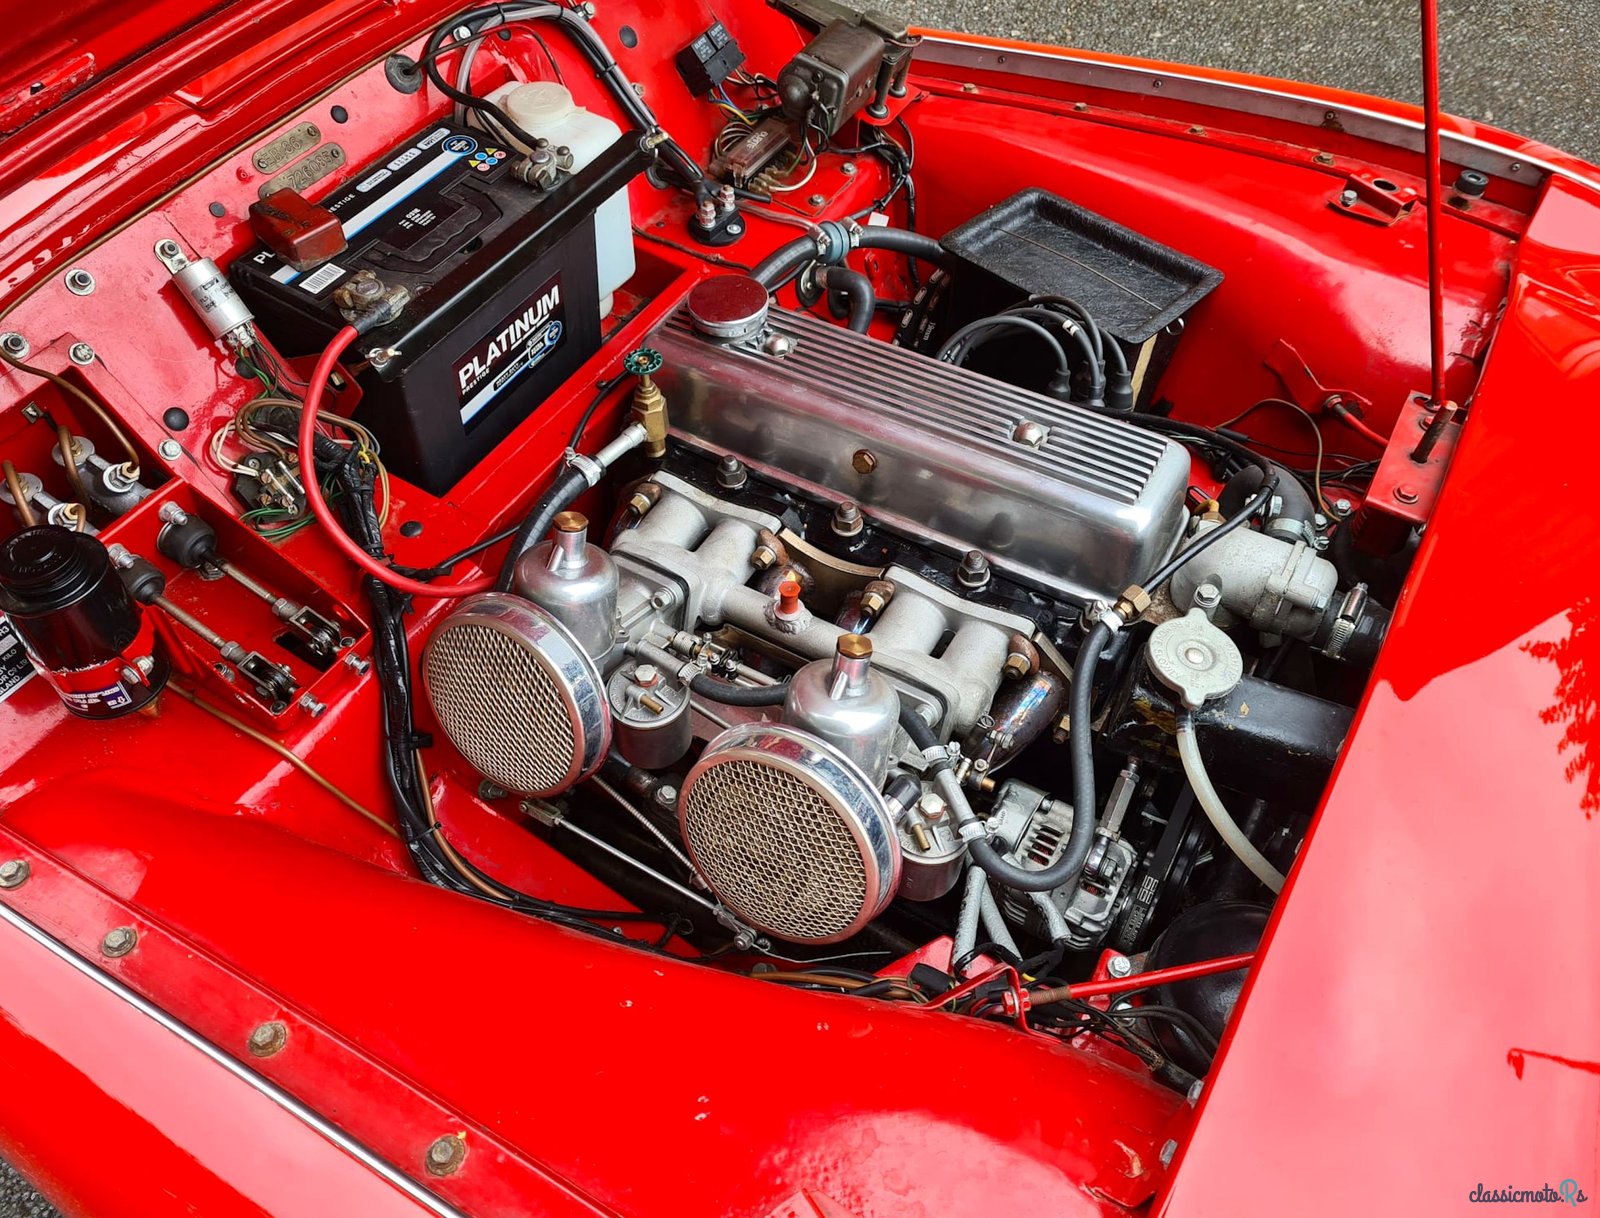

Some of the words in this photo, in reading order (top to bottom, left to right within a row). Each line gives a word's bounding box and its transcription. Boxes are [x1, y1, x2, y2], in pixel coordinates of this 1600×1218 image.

[327, 193, 356, 213] ESTIGE
[458, 284, 560, 390] PLATINUM
[461, 367, 490, 396] PRESTIGE
[1, 648, 17, 662] KILO
